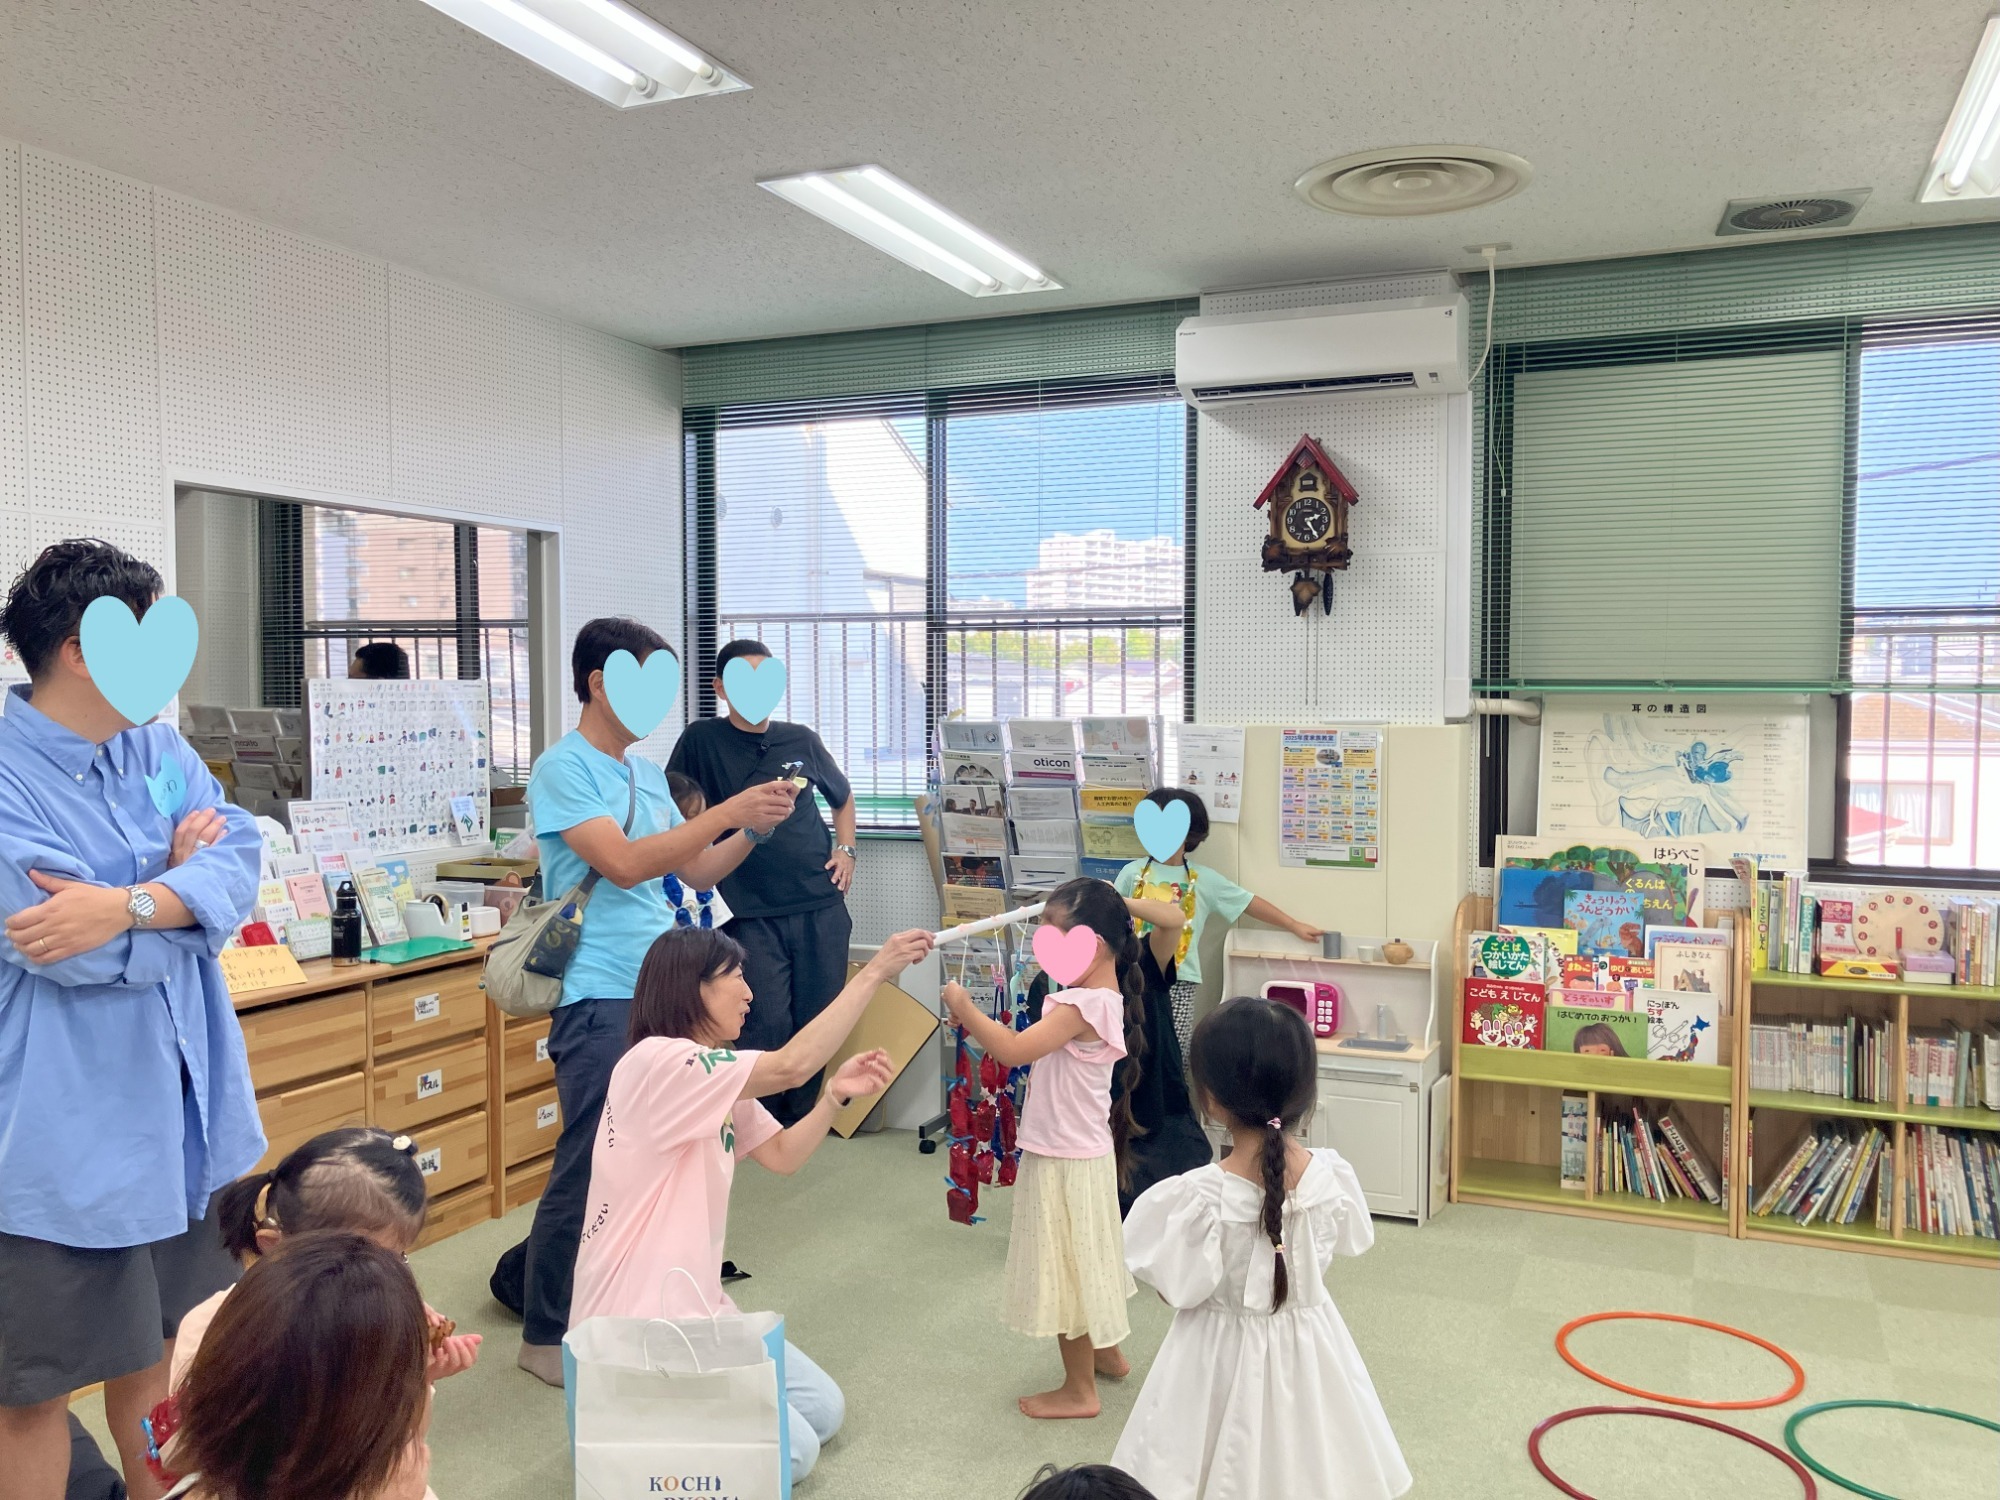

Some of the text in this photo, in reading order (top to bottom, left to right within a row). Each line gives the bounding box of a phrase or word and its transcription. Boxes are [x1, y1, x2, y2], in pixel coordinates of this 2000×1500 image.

[1631, 703, 1707, 714] 耳の構造図
[1034, 758, 1070, 768] oticon
[1584, 893, 1627, 905] きょうりゅう
[1577, 902, 1634, 916] うんどうかい
[1490, 942, 1522, 952] ことば
[1483, 952, 1529, 961] つかいかた
[1488, 960, 1526, 970] 絵じてん
[1470, 988, 1497, 998] こども
[1500, 990, 1510, 1000] え
[1513, 991, 1541, 1002] じてん
[1647, 1000, 1680, 1010] にっぽん
[1557, 1010, 1636, 1023] はじめてのおつかい
[1648, 1008, 1664, 1016] ちず
[1648, 1016, 1664, 1024] 絵本
